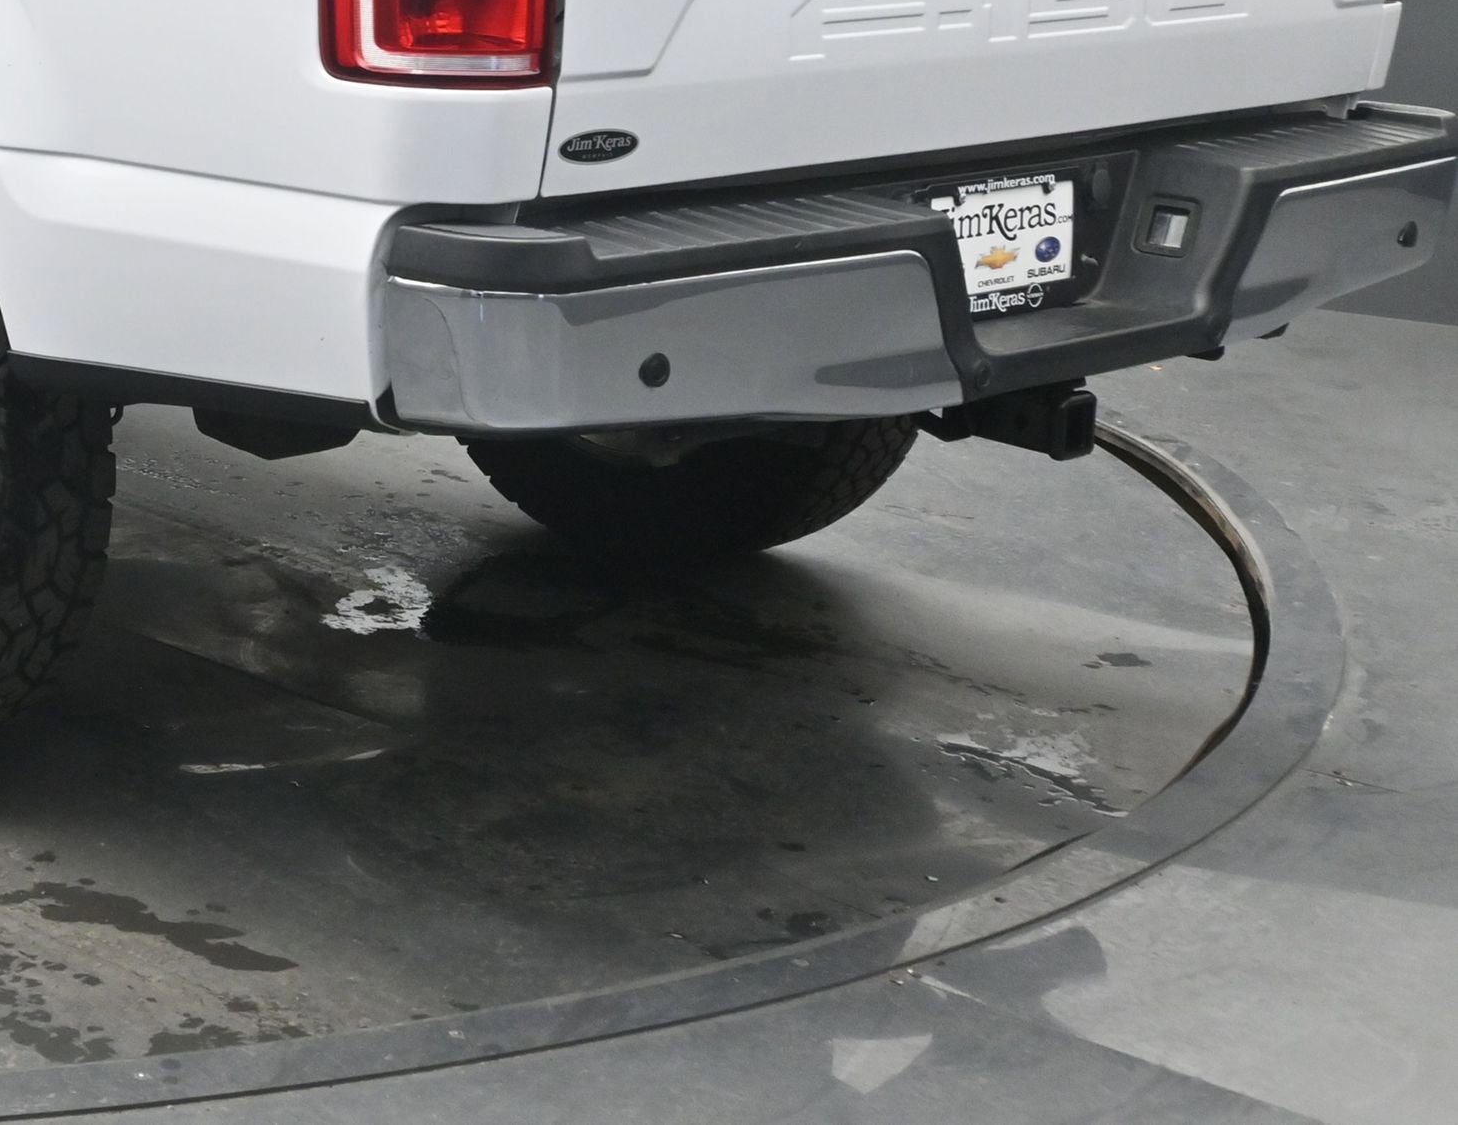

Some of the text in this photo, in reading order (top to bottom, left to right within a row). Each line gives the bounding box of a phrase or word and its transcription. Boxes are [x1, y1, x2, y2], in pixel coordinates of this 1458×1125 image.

[957, 173, 1056, 194] www.jimkeras.com
[1027, 264, 1066, 279] SUBARU
[978, 275, 1015, 288] CHEVROLET
